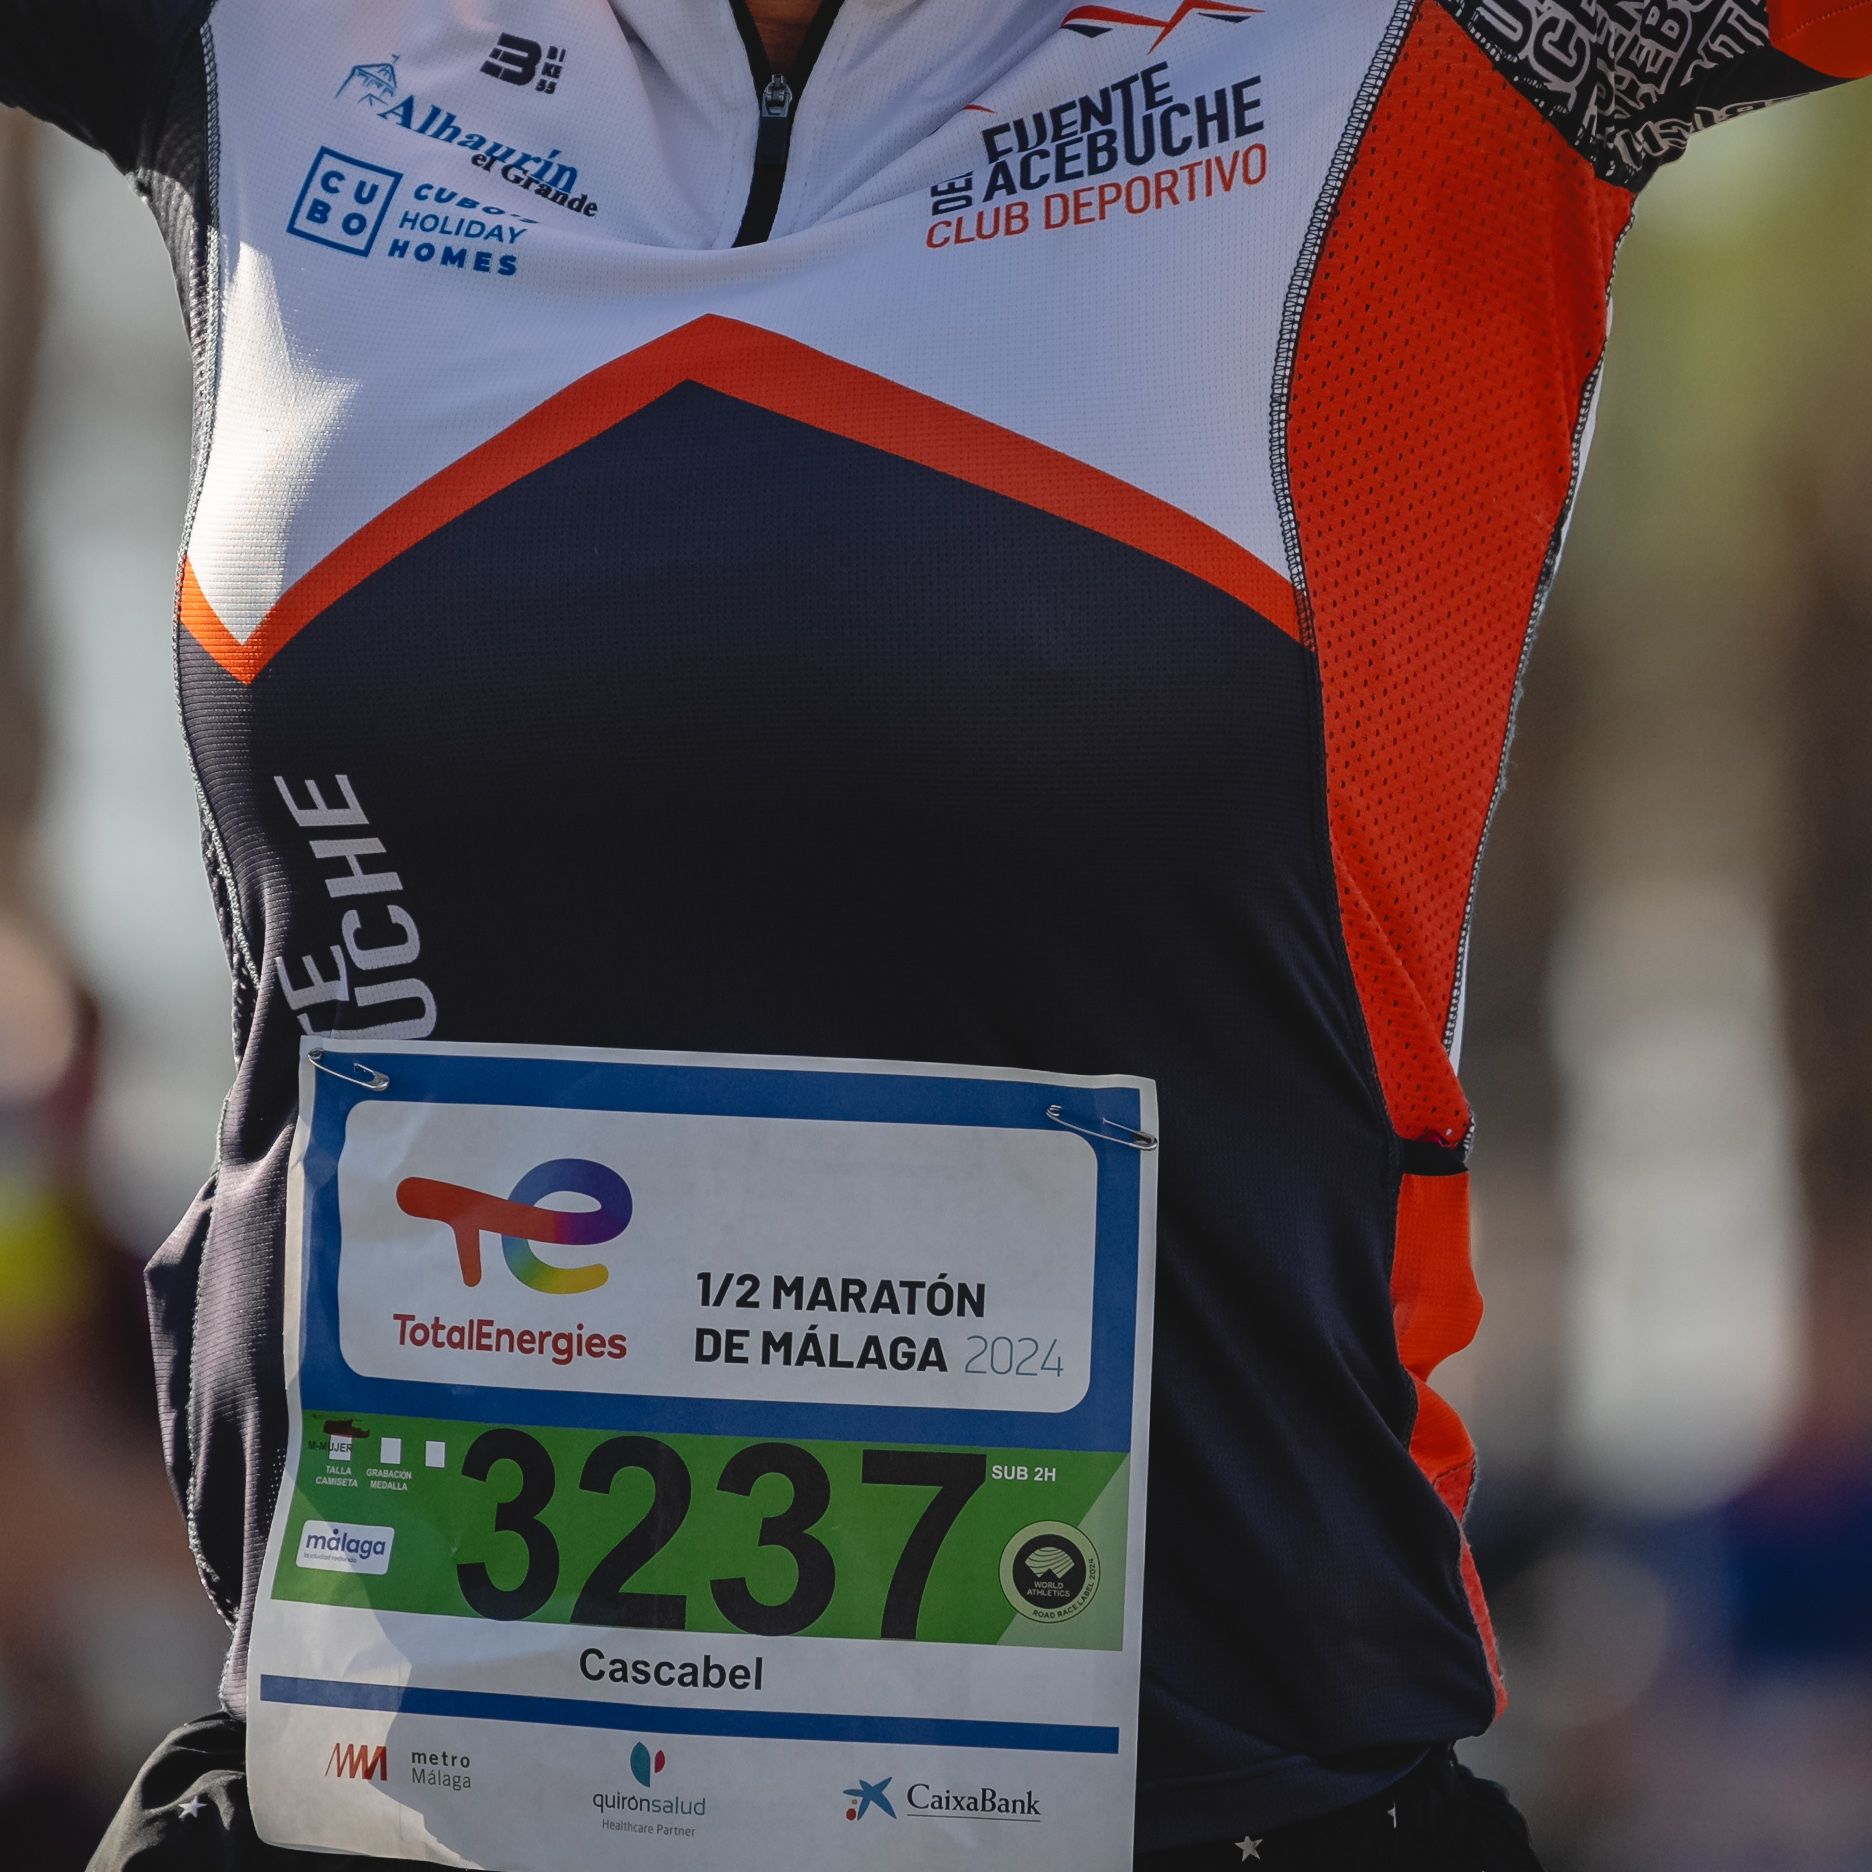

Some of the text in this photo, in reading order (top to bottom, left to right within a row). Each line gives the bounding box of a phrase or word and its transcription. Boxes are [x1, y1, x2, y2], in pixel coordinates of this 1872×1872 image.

[981, 61, 1174, 164] FUENTE
[377, 94, 579, 193] Alhaurín
[982, 75, 1265, 203] ACEBUCHE
[471, 152, 598, 217] el Grande
[926, 143, 1268, 249] CLUB DEPORTIVO
[399, 210, 527, 244] HOLIDAY
[388, 238, 518, 276] HOMES
[696, 1272, 986, 1318] 1/2 MARATÓN
[393, 1313, 627, 1366] TotalEnergies
[694, 1324, 1064, 1377] DE MÁLAGA 2024
[315, 1476, 358, 1488] CAMISETA
[326, 1465, 352, 1475] TALLA
[370, 1480, 408, 1491] MEDALLA
[991, 1465, 1057, 1482] SUB 2H
[456, 1427, 987, 1641] 3237
[1027, 1588, 1071, 1597] ATHLETICS
[1032, 1609, 1055, 1619] ROAD
[1057, 1604, 1078, 1617] RACE
[1077, 1582, 1095, 1607] LABEL
[1034, 1581, 1064, 1590] WORLD
[579, 1647, 763, 1690] Cascabel
[411, 1751, 471, 1769] metro
[411, 1768, 472, 1791] Málaga
[592, 1790, 706, 1817] quirónsalud
[907, 1783, 1042, 1816] CaixaBank
[601, 1818, 696, 1838] Healthcare Partner
